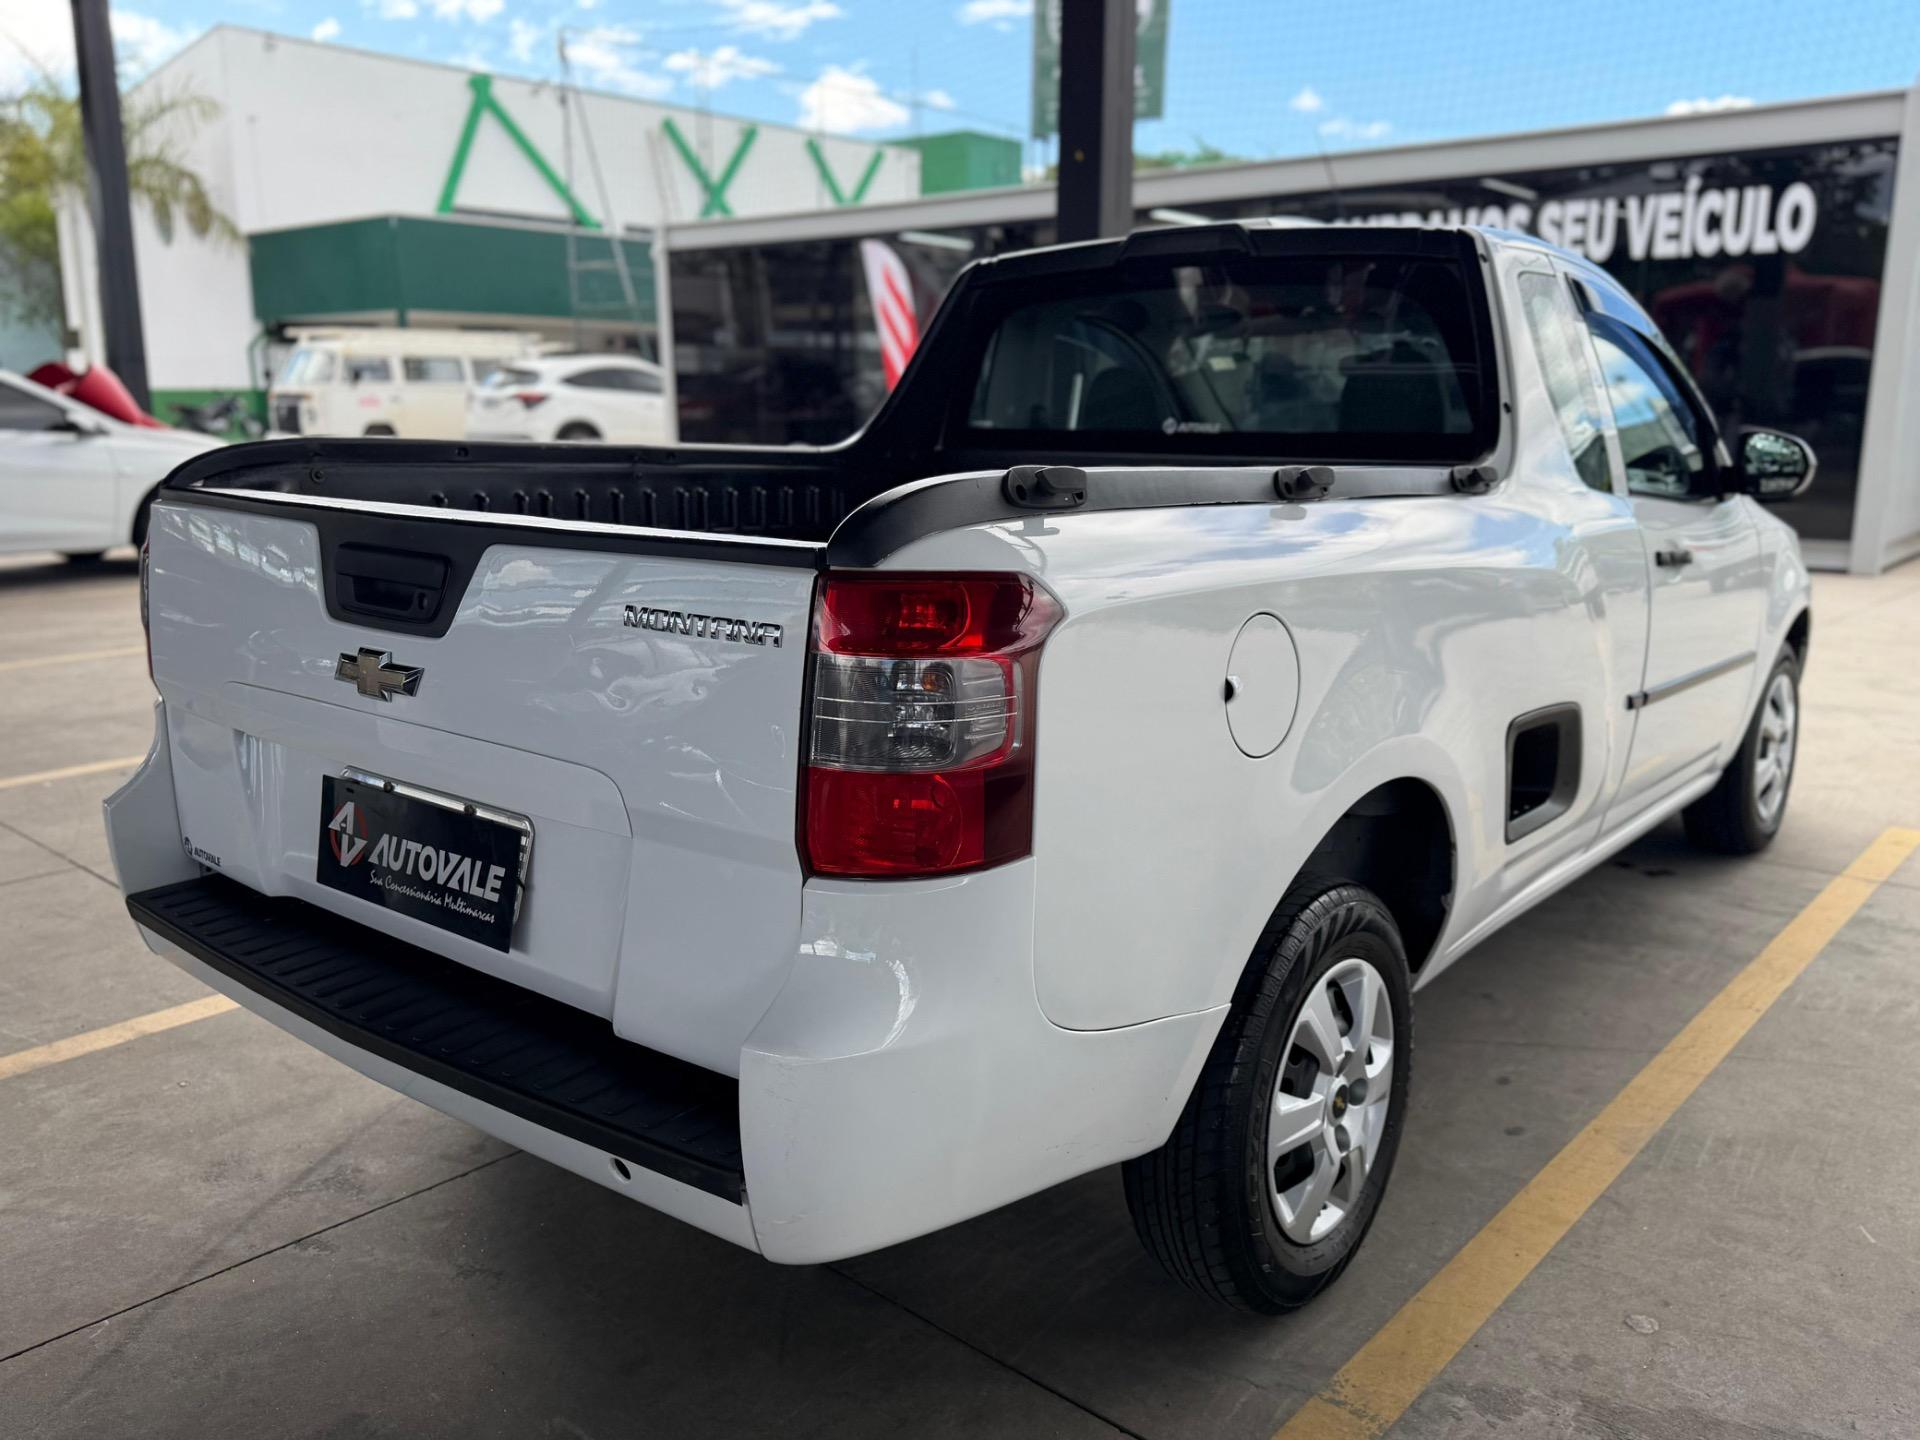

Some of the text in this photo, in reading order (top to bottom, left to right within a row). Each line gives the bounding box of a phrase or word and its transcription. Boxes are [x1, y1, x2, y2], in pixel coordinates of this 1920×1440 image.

[1538, 175, 1817, 262] SEU VEÍCULO
[623, 604, 783, 648] MONTANA
[194, 847, 222, 867] AUTOVALE
[368, 833, 506, 903] AUTOVALE
[370, 869, 496, 924] Sua Concessionária Multimarcas
